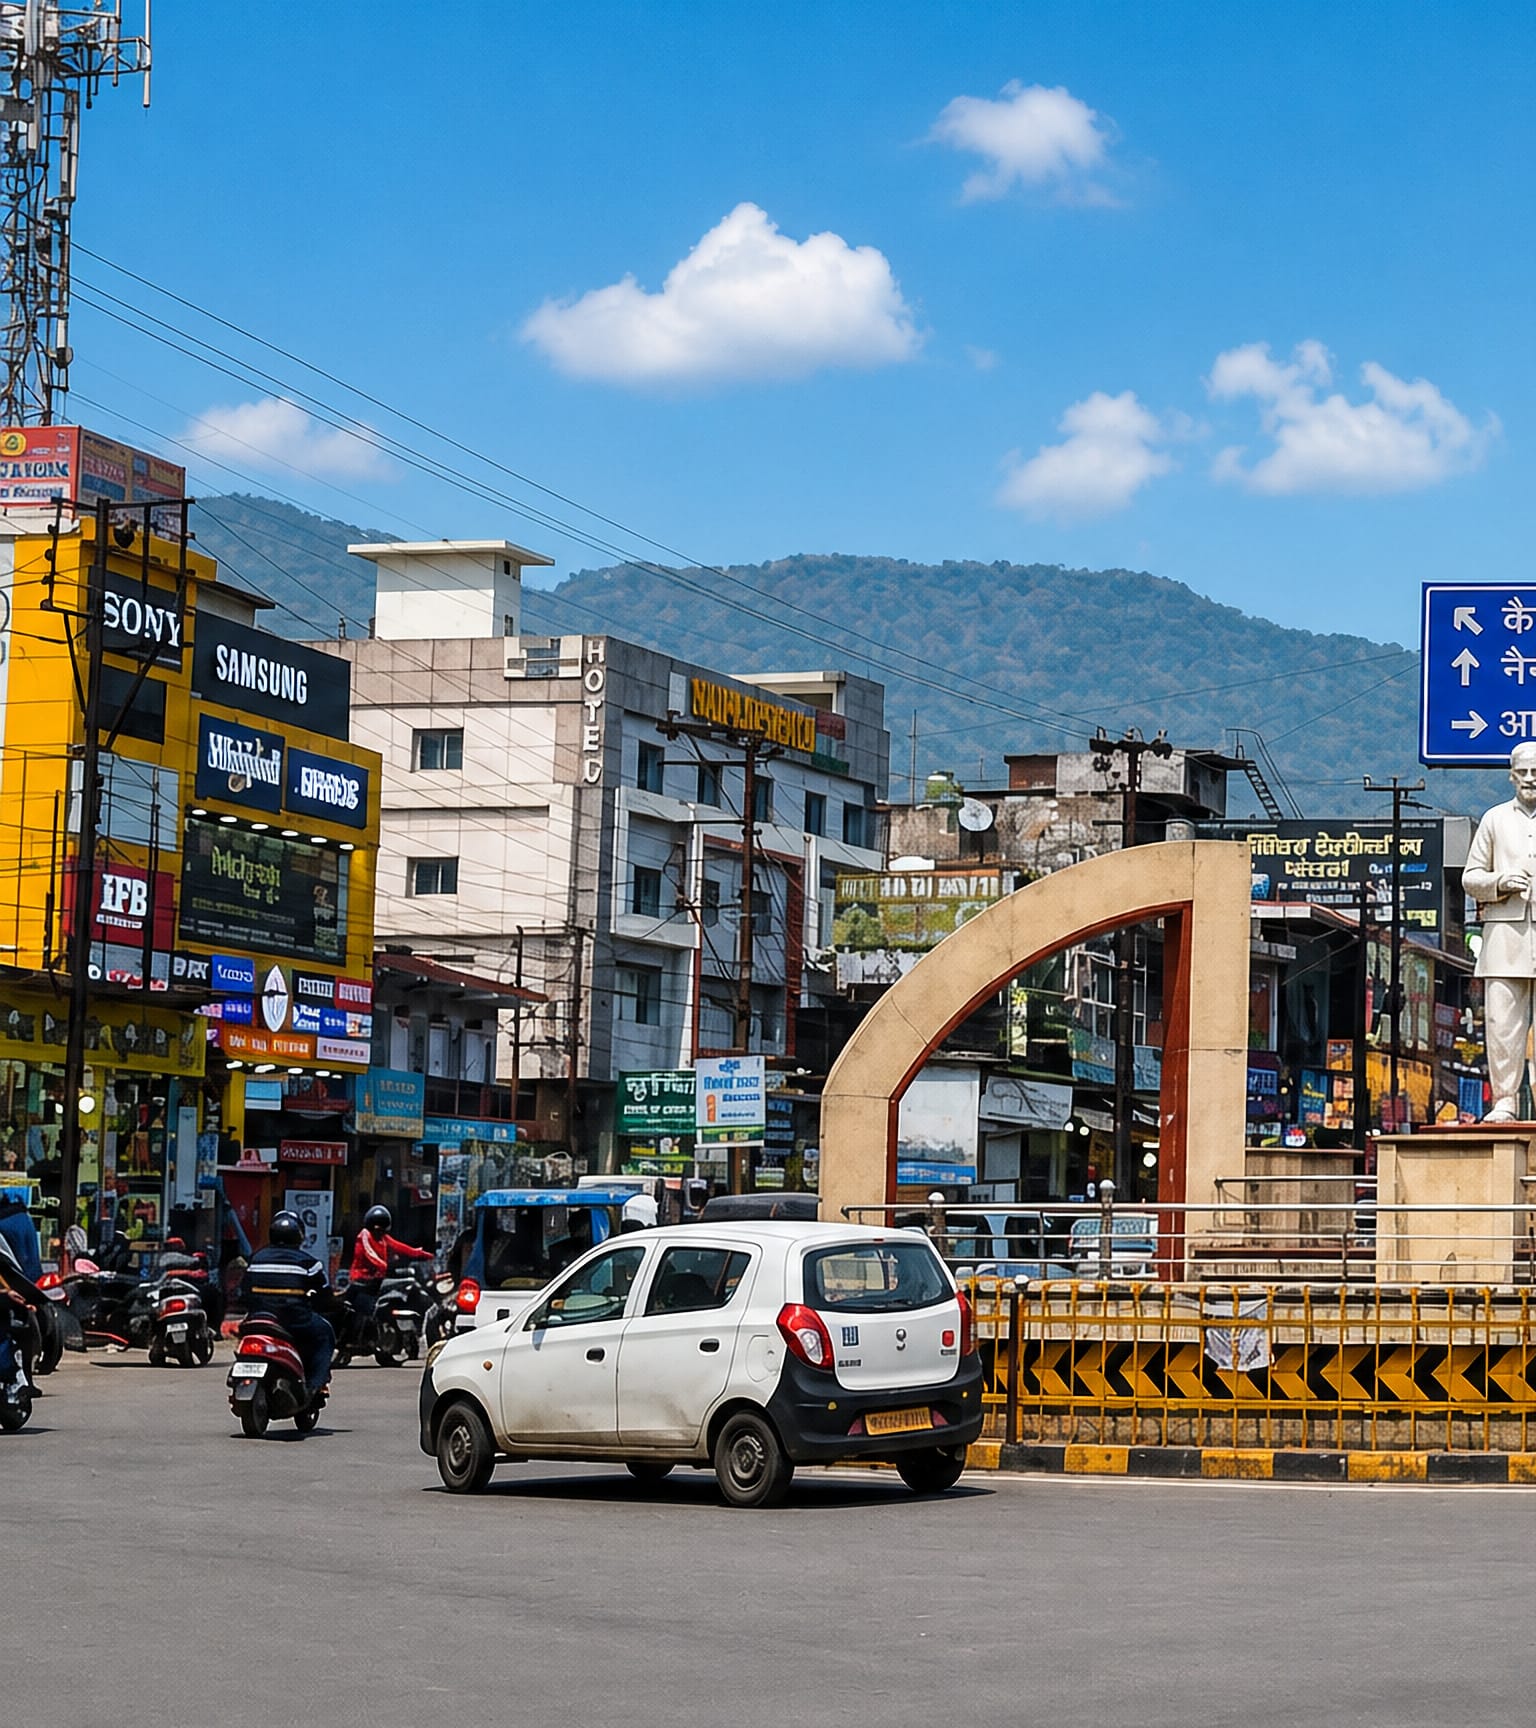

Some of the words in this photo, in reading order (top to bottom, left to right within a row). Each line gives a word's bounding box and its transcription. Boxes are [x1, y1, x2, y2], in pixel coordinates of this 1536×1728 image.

[104, 590, 181, 648] SONY
[216, 643, 308, 705] SAMSUNG
[100, 872, 148, 917] IFB
